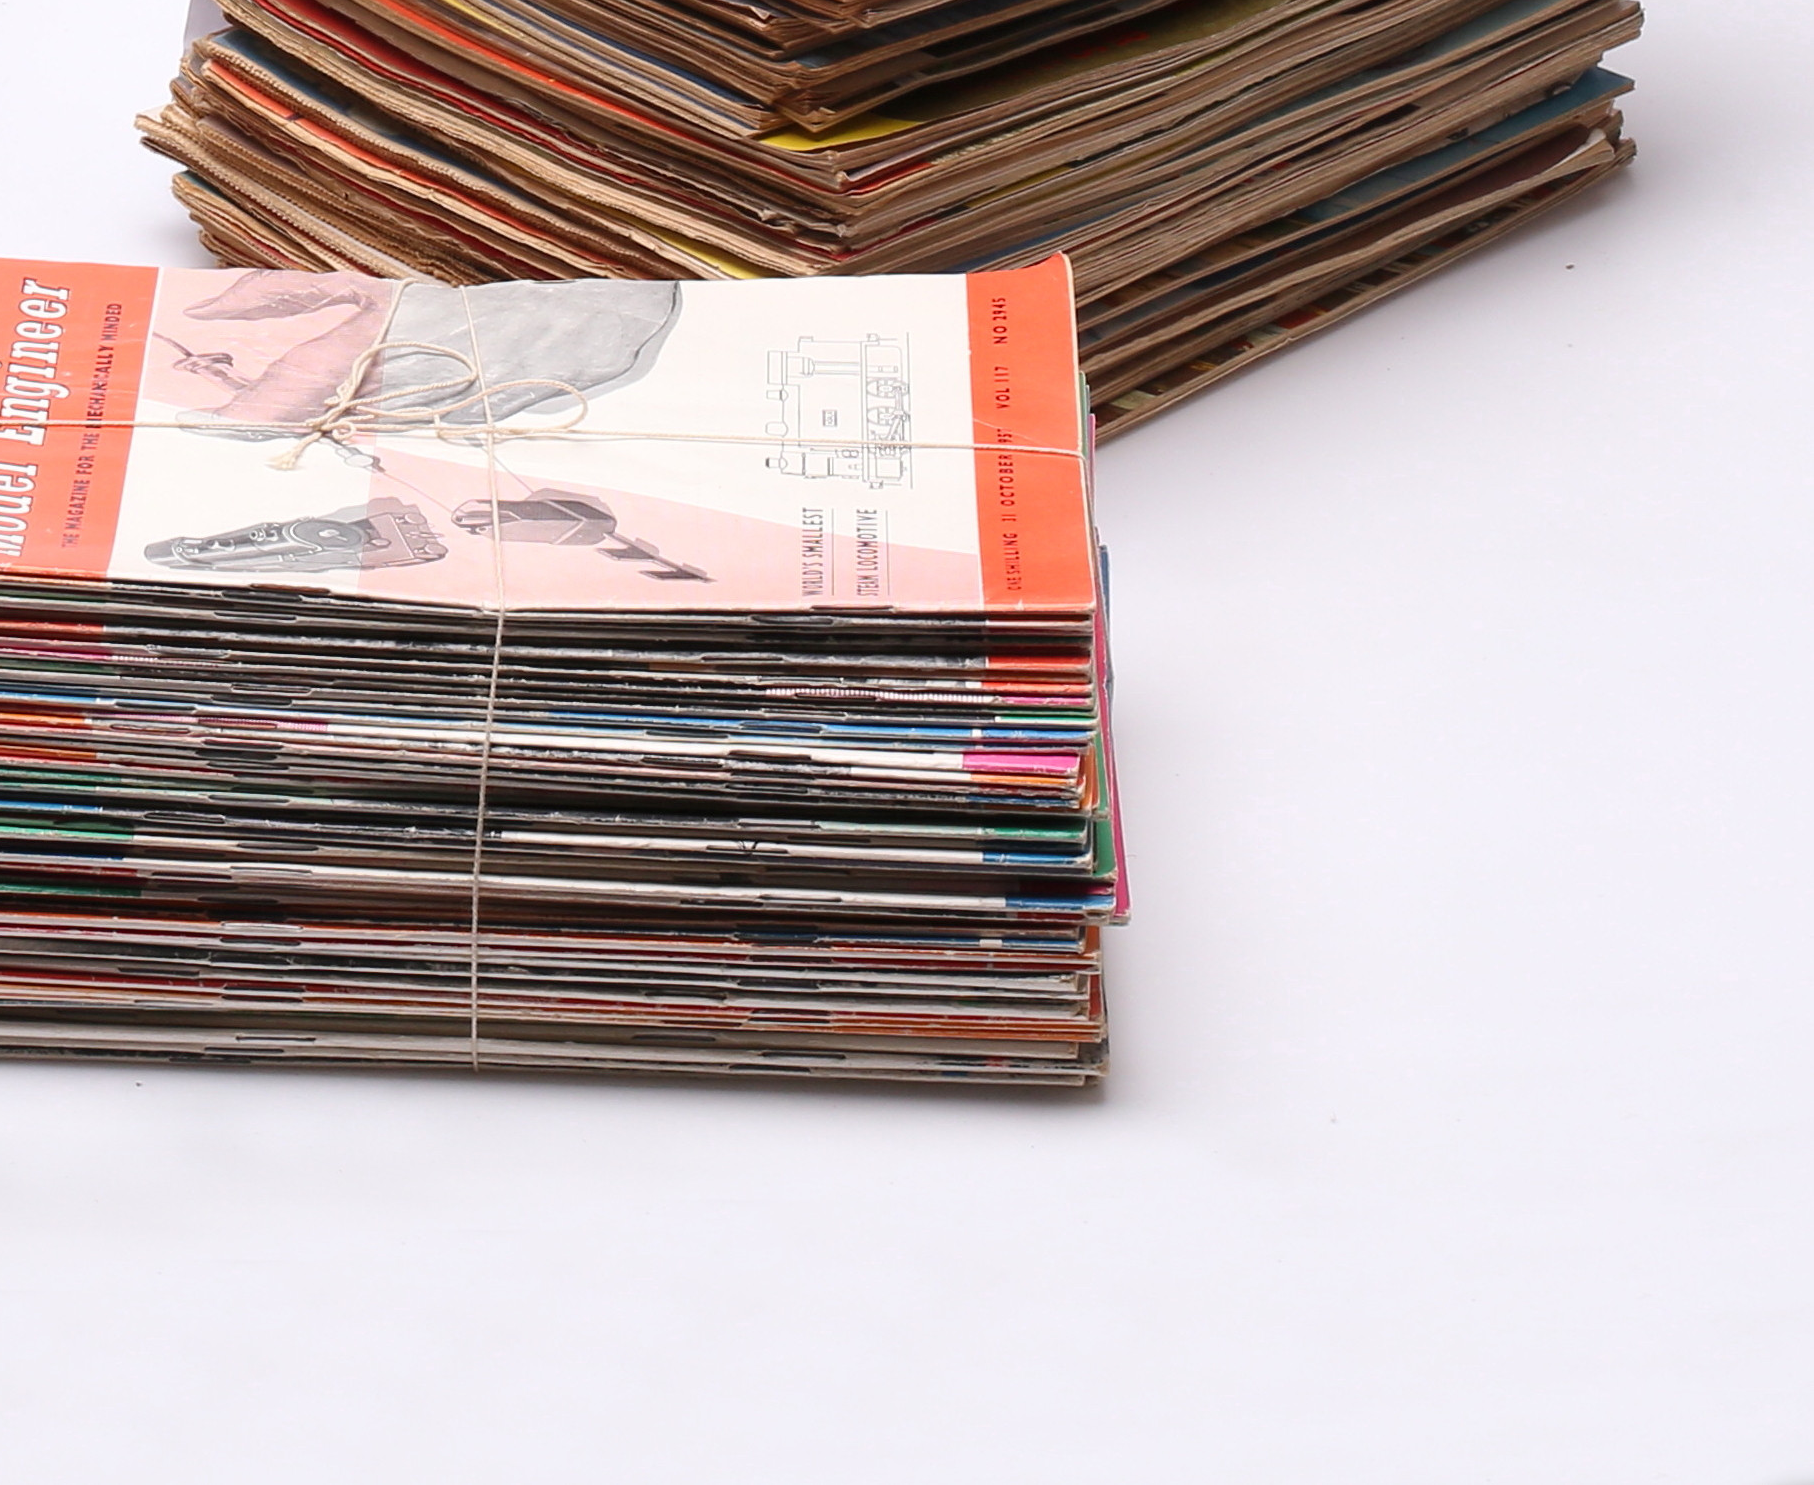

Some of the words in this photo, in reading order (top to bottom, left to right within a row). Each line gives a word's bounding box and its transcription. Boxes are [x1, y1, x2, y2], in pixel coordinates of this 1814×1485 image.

[101, 303, 122, 342] MINDED
[992, 297, 1006, 323] 2945
[993, 326, 1007, 345] NO
[994, 366, 1009, 382] 117
[996, 384, 1010, 409] VOL
[82, 433, 100, 453] THE
[76, 456, 93, 475] FOR
[998, 455, 1015, 507] OCTOBER
[64, 479, 91, 531] MAGAZINE
[61, 532, 79, 548] THE
[802, 507, 823, 558] SMALLEST
[856, 508, 878, 572] LOCOMOTIVE
[1003, 533, 1020, 575] SHILLING
[802, 560, 823, 597] WORLD'S
[856, 575, 878, 597] STEAM
